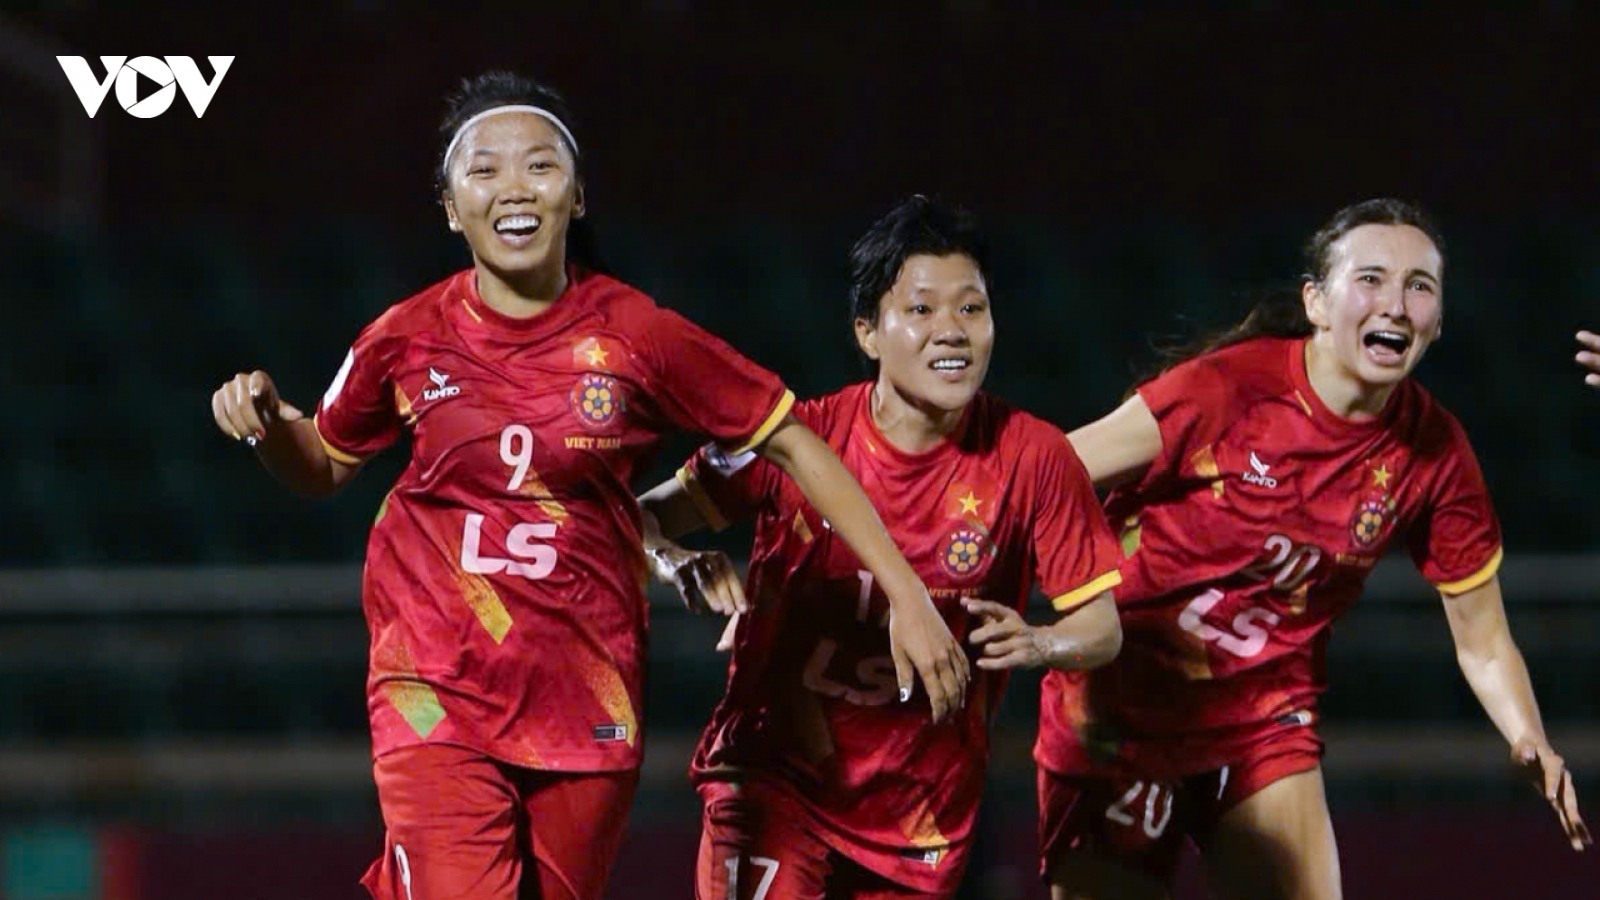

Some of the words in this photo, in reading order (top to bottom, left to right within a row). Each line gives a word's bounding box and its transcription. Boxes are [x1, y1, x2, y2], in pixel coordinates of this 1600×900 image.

[500, 424, 533, 490] 9
[565, 437, 595, 449] VIET
[597, 437, 621, 449] NAM
[460, 513, 557, 579] LS
[1240, 535, 1322, 590] 20
[1178, 588, 1281, 658] LS
[803, 637, 898, 706] LS
[725, 856, 780, 900] 17
